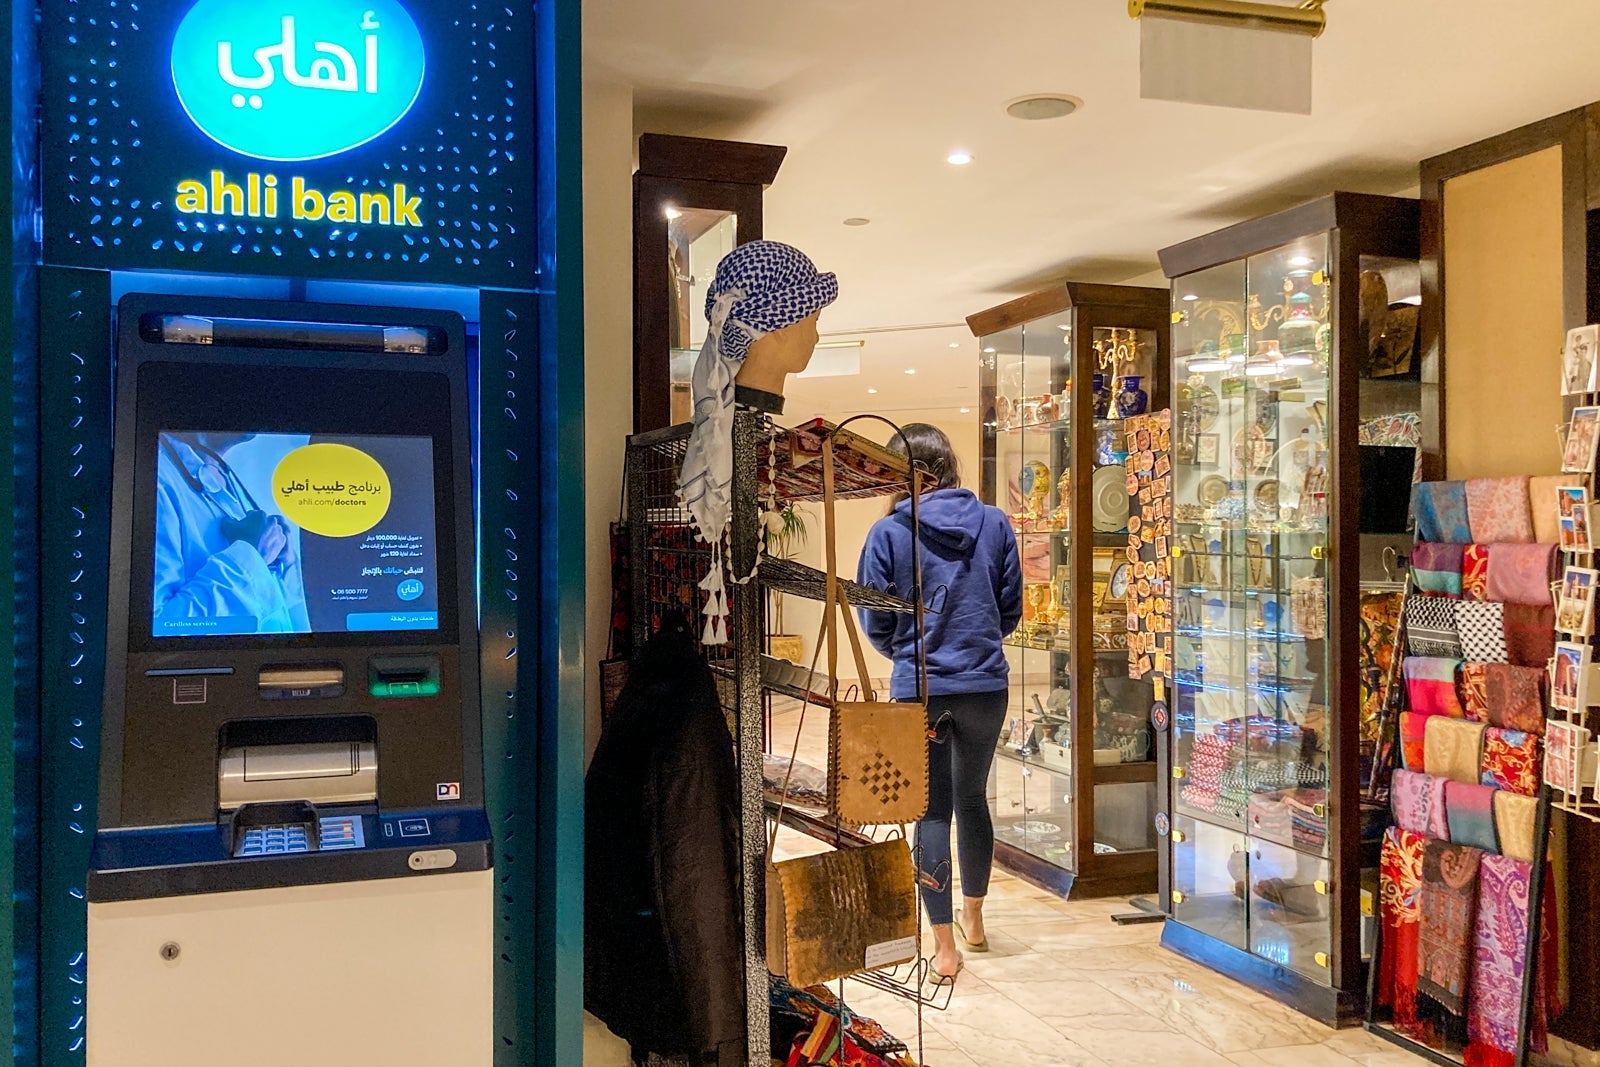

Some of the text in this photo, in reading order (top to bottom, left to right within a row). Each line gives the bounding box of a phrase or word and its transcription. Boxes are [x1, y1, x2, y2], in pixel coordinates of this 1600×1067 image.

[217, 10, 380, 110] أهلي
[175, 169, 423, 227] ahli bank
[281, 479, 381, 497] برنامج طبيب أهلي
[298, 498, 367, 506] ahli.com/doctors
[401, 582, 419, 596] أهلي
